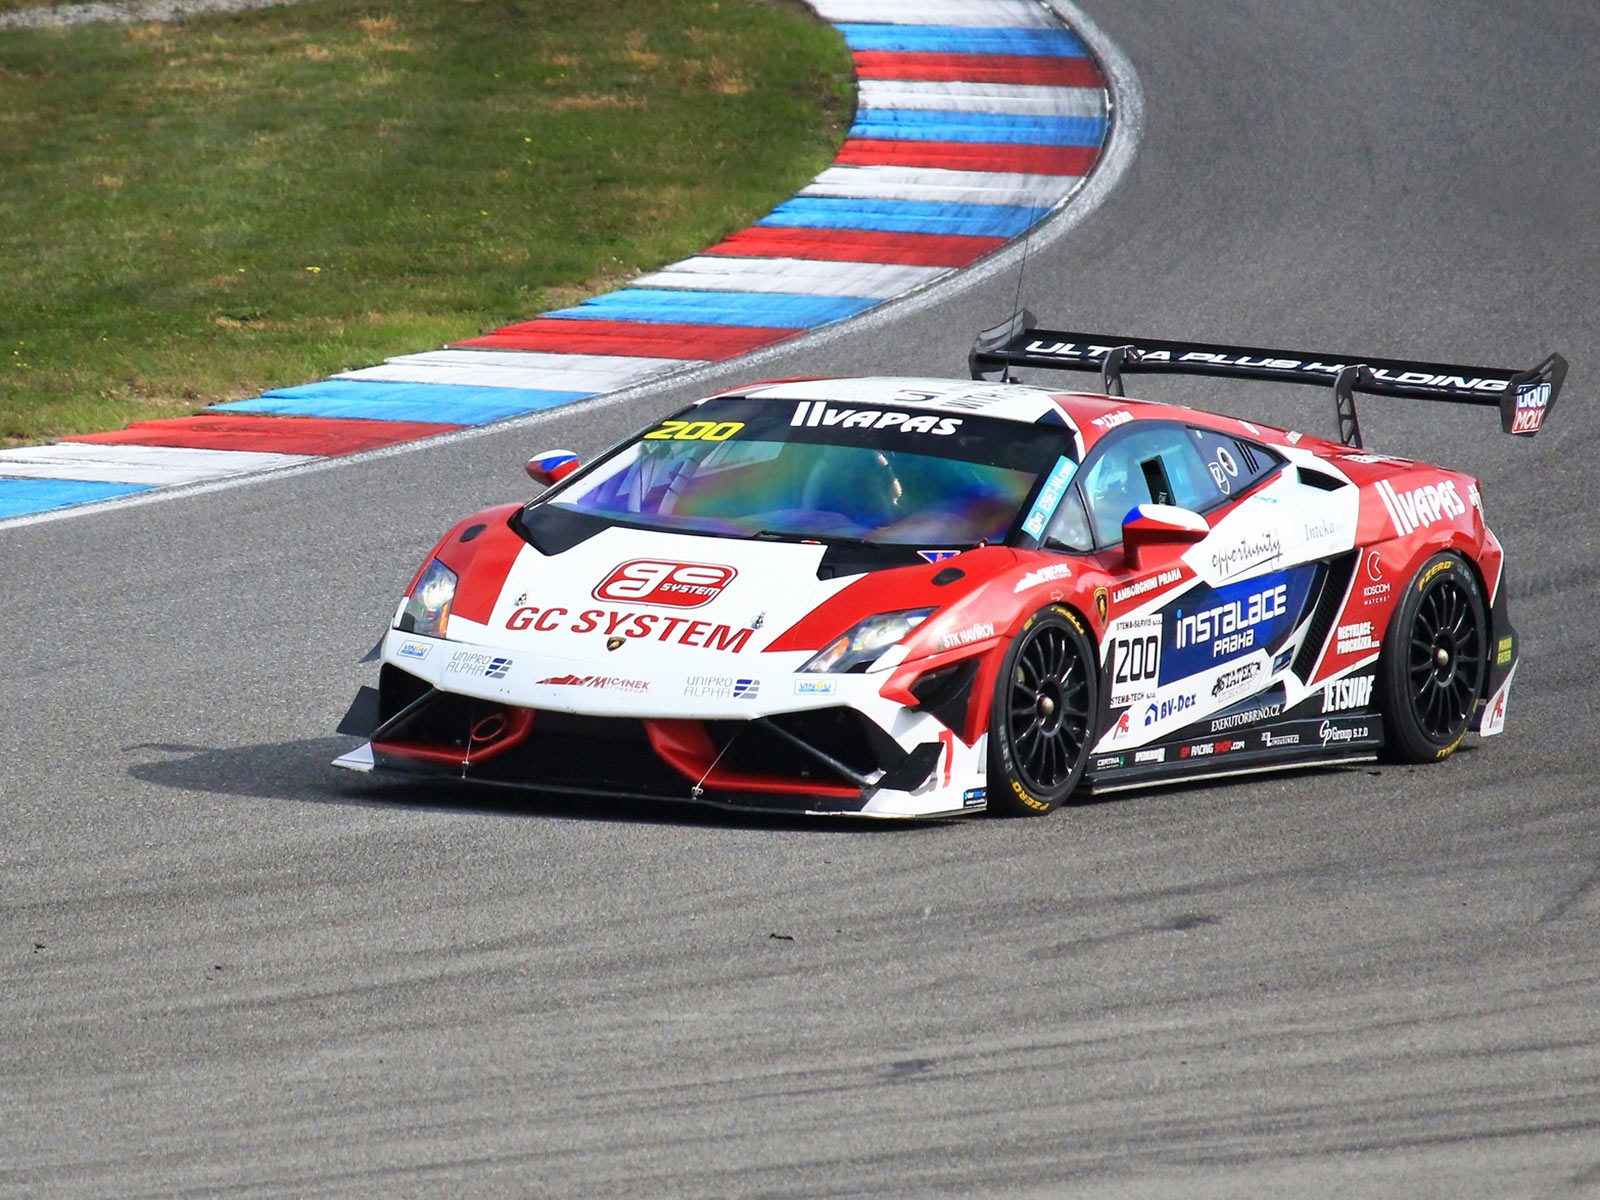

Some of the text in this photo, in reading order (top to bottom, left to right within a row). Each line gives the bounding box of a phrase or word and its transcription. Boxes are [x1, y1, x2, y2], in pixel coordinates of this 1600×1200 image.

[1025, 340, 1510, 391] ULTA PLUS HLDING
[1518, 386, 1549, 408] LIQUI
[1514, 409, 1545, 430] MOLY
[642, 420, 746, 442] 200
[659, 582, 722, 597] SYSTEM
[1112, 567, 1183, 604] LAMBORGHINI PRAHA
[505, 607, 755, 654] GC SYSTEM
[445, 661, 487, 676] ALPHA
[452, 651, 492, 665] UNIPRO
[1115, 635, 1159, 685] 200
[686, 675, 734, 687] UNIPRO
[684, 686, 731, 699] ALPHA
[1322, 674, 1376, 714] JETSURF
[1160, 693, 1197, 720] BV-Dex
